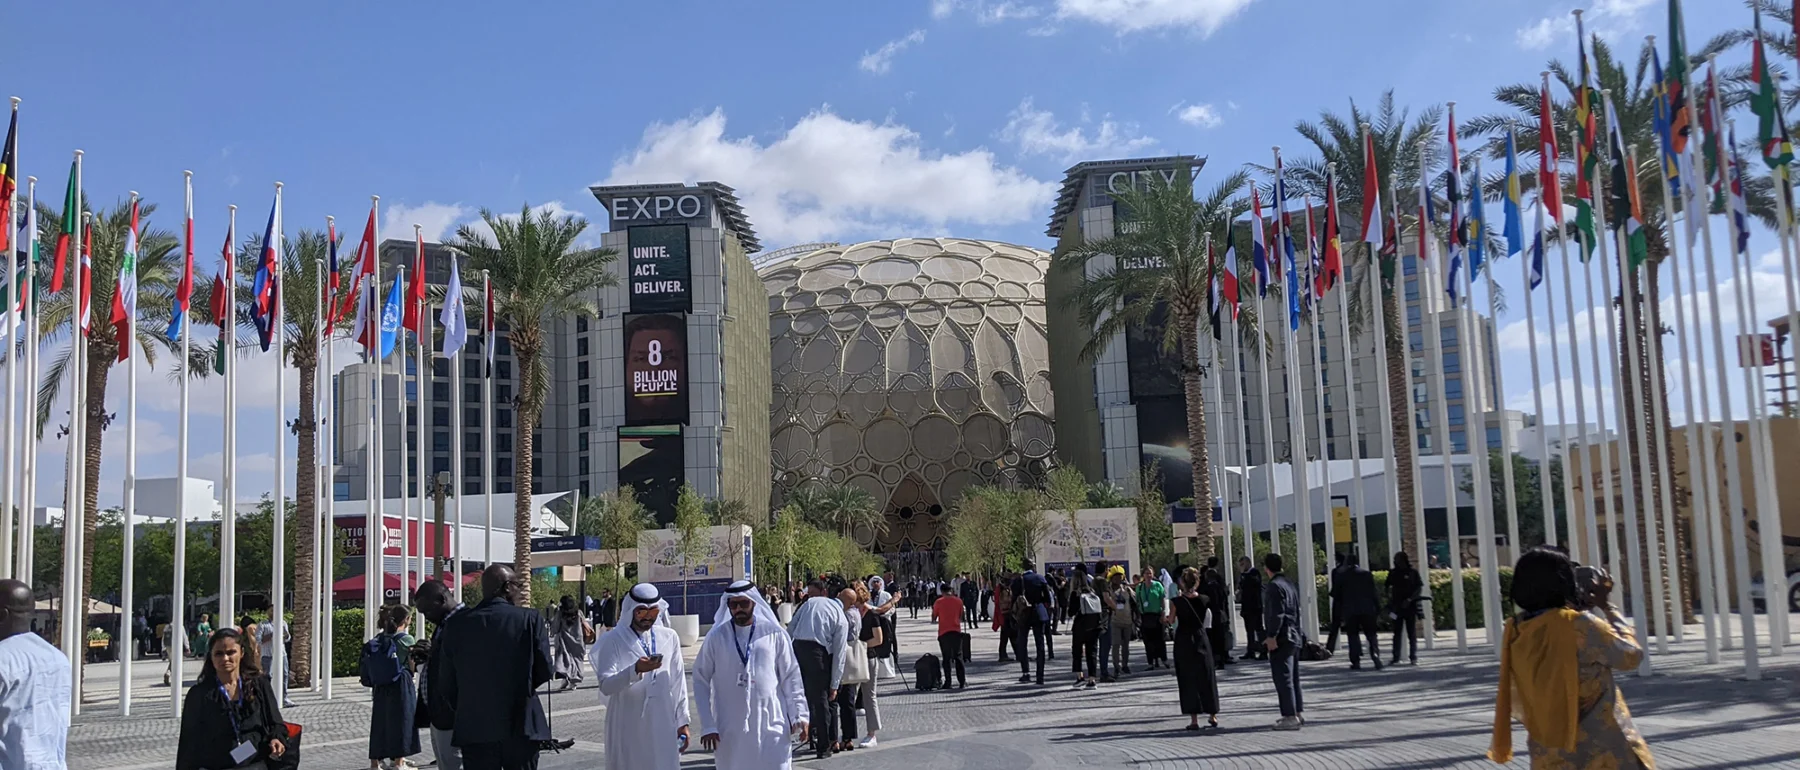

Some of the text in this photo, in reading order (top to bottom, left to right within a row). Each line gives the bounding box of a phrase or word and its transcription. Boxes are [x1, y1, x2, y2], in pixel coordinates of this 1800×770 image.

[612, 195, 700, 220] EXPO
[633, 246, 670, 259] UNITE.
[634, 263, 659, 276] ACT.
[634, 281, 685, 294] DELIVER.
[648, 339, 662, 366] 8
[633, 369, 677, 383] BILLION
[634, 381, 678, 392] PEOPLE
[389, 539, 401, 547] COFFE
